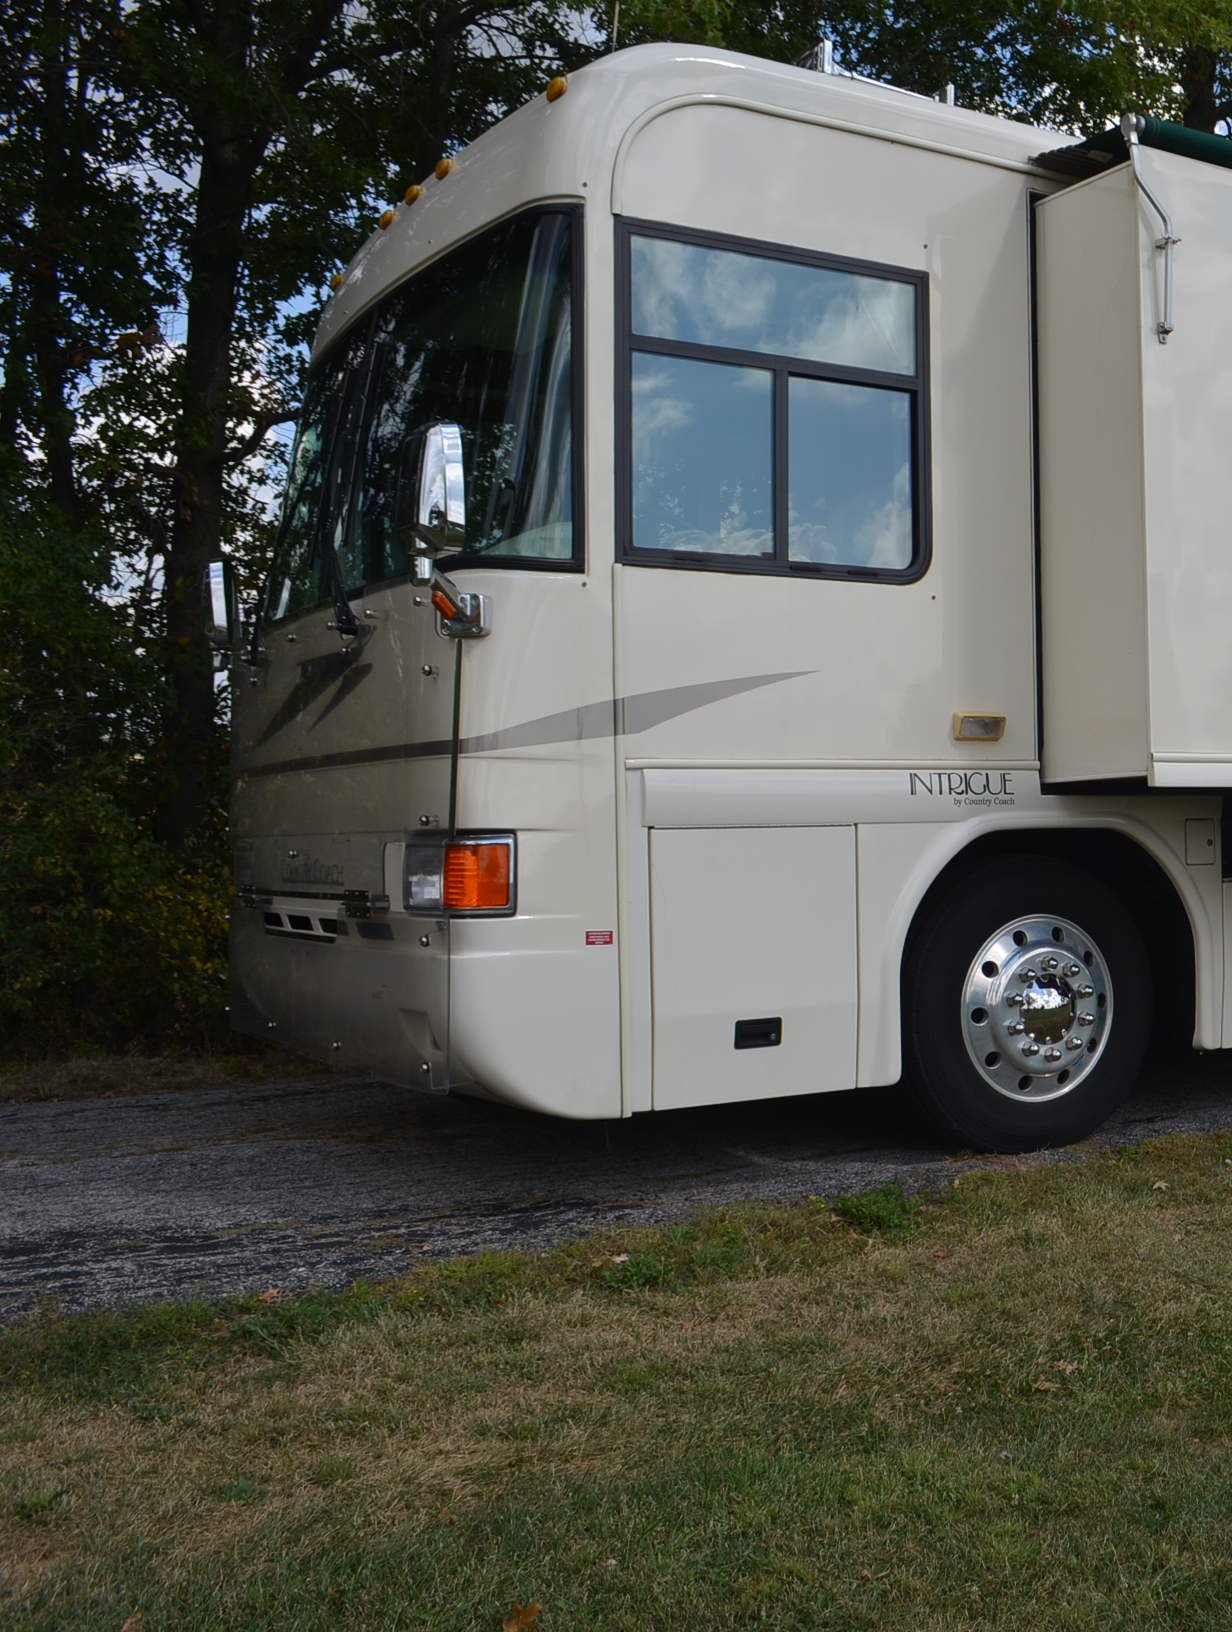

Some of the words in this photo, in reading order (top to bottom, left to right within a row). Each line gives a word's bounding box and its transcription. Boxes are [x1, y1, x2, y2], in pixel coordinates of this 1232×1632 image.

[908, 772, 1015, 795] INTRIGUE
[953, 797, 962, 807] by
[964, 797, 992, 807] Country
[993, 797, 1015, 805] Coach
